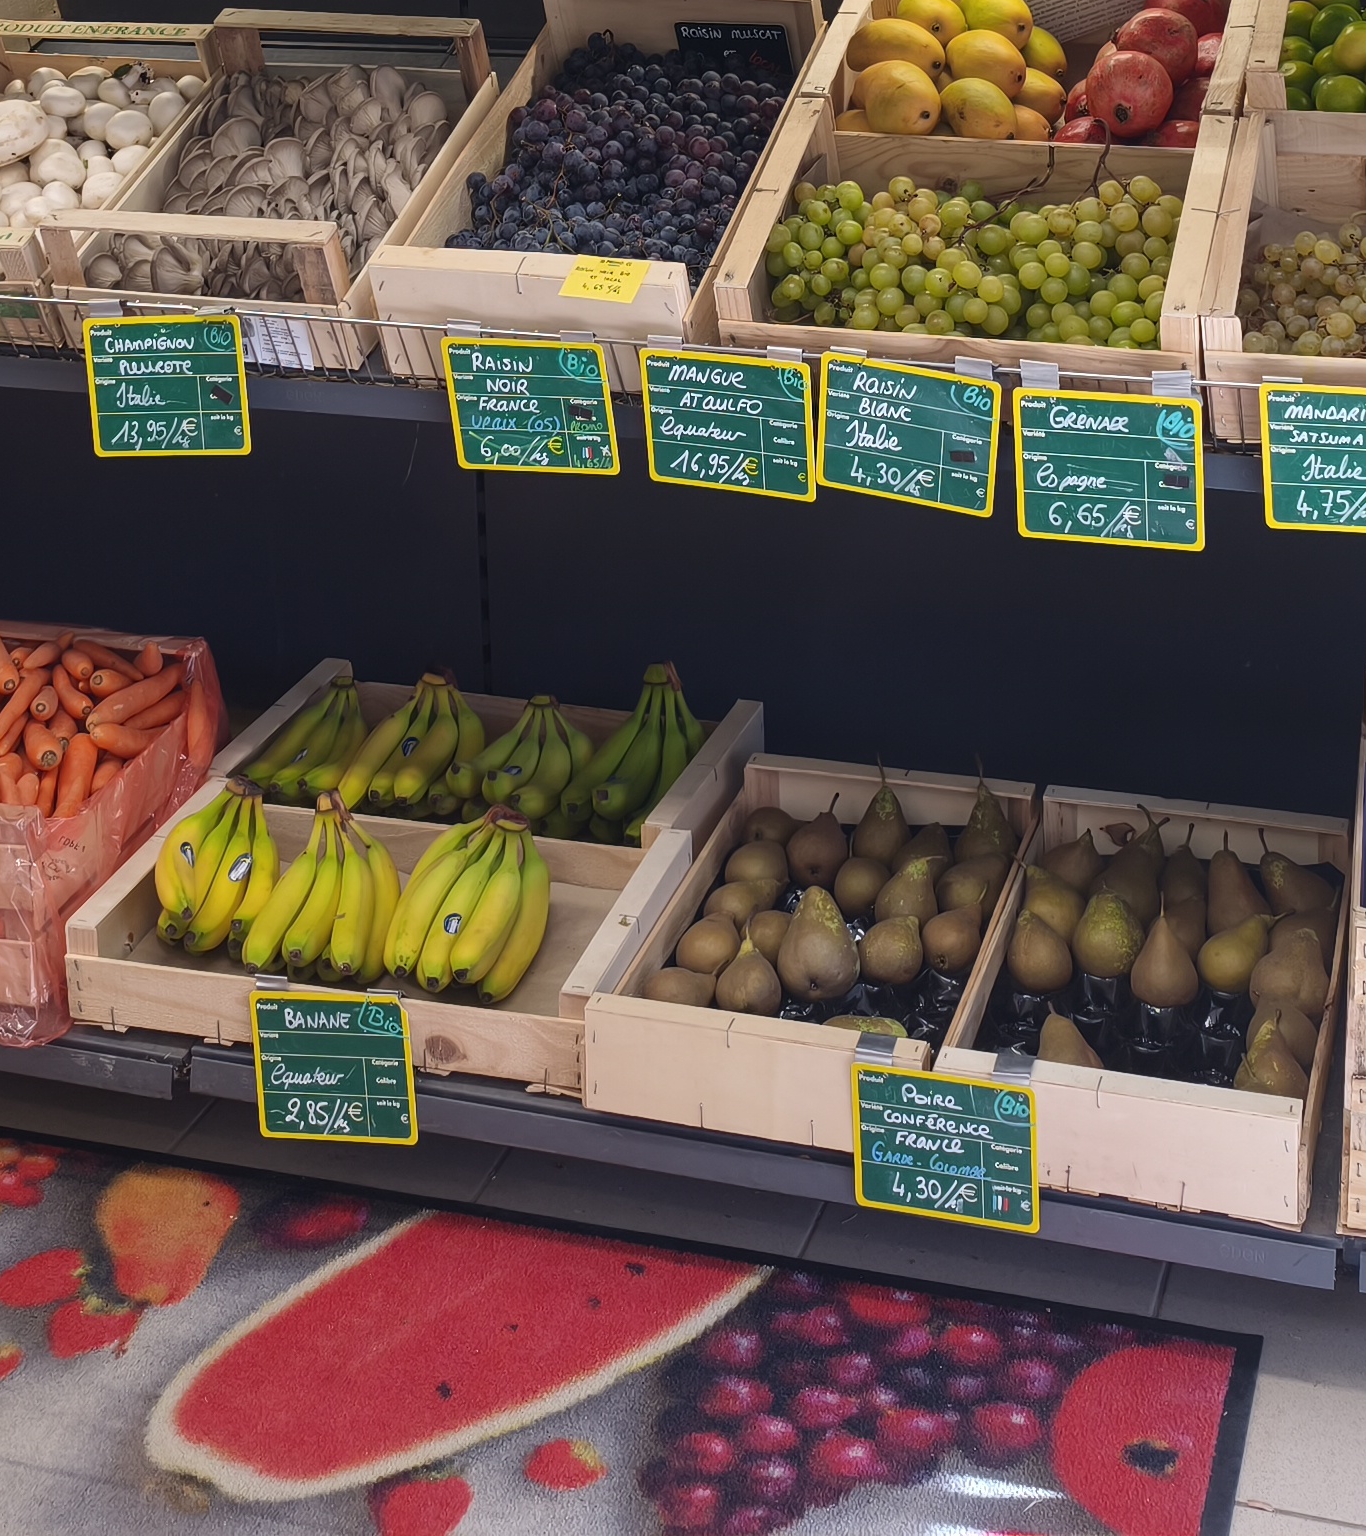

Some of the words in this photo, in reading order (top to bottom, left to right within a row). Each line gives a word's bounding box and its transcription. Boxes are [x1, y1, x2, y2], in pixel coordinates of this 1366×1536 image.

[100, 24, 191, 37] FRANCE
[668, 363, 748, 389] MANGUE
[486, 377, 531, 396] NOIR
[1288, 430, 1366, 447] SATSUMA
[283, 1007, 353, 1030] BANANE
